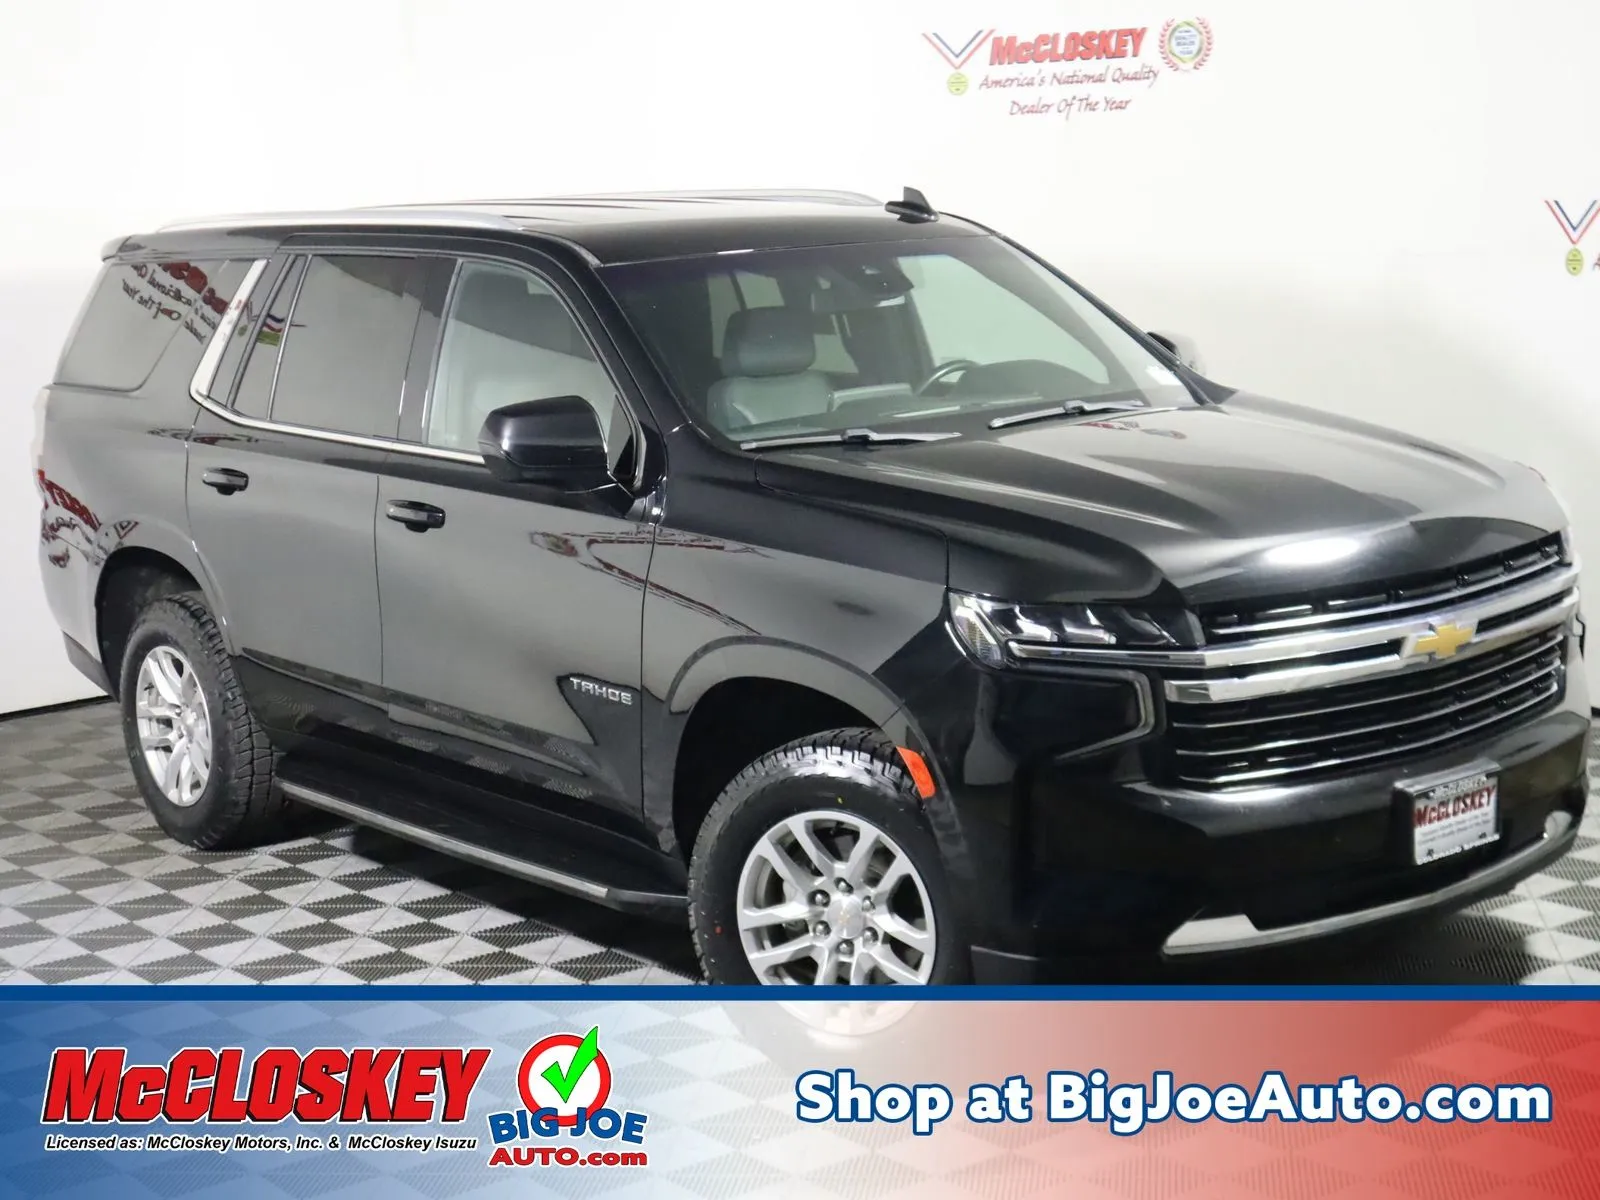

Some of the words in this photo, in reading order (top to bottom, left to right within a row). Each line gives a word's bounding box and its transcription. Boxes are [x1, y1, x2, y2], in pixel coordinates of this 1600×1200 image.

[989, 27, 1148, 66] McCLOSKEY
[978, 68, 1046, 90] America's
[1050, 65, 1107, 86] National
[1111, 62, 1160, 88] Quality
[1009, 97, 1053, 116] Dealer
[1056, 95, 1077, 121] Of
[1076, 94, 1100, 112] The
[1103, 96, 1132, 112] Year
[569, 676, 632, 705] TAHOE
[1414, 787, 1496, 828] McCLOSKEY
